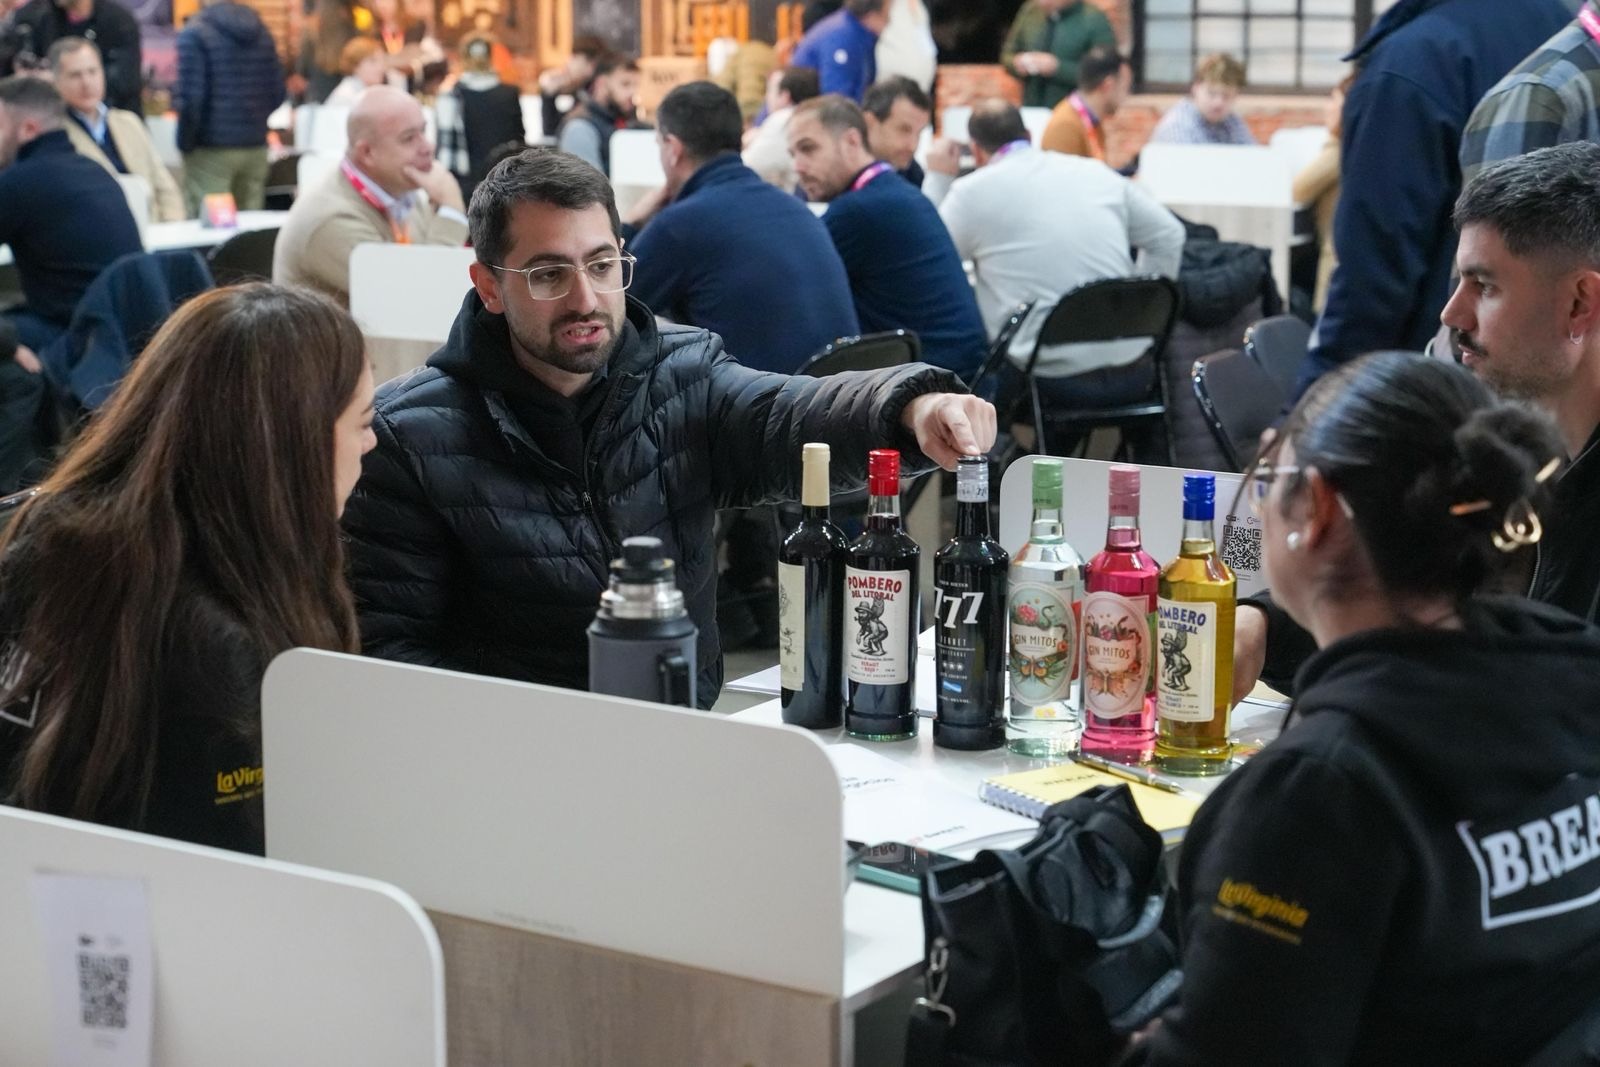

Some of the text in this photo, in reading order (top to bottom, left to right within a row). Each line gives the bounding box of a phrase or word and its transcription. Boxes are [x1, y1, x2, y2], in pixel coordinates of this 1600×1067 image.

[848, 576, 902, 593] POMBERO
[851, 590, 895, 602] DEL LITORAL
[1157, 606, 1206, 626] OMBERO
[1167, 621, 1198, 635] LITORAL
[1014, 634, 1057, 648] GIN MITOS
[1088, 644, 1130, 660] GIN MITOS
